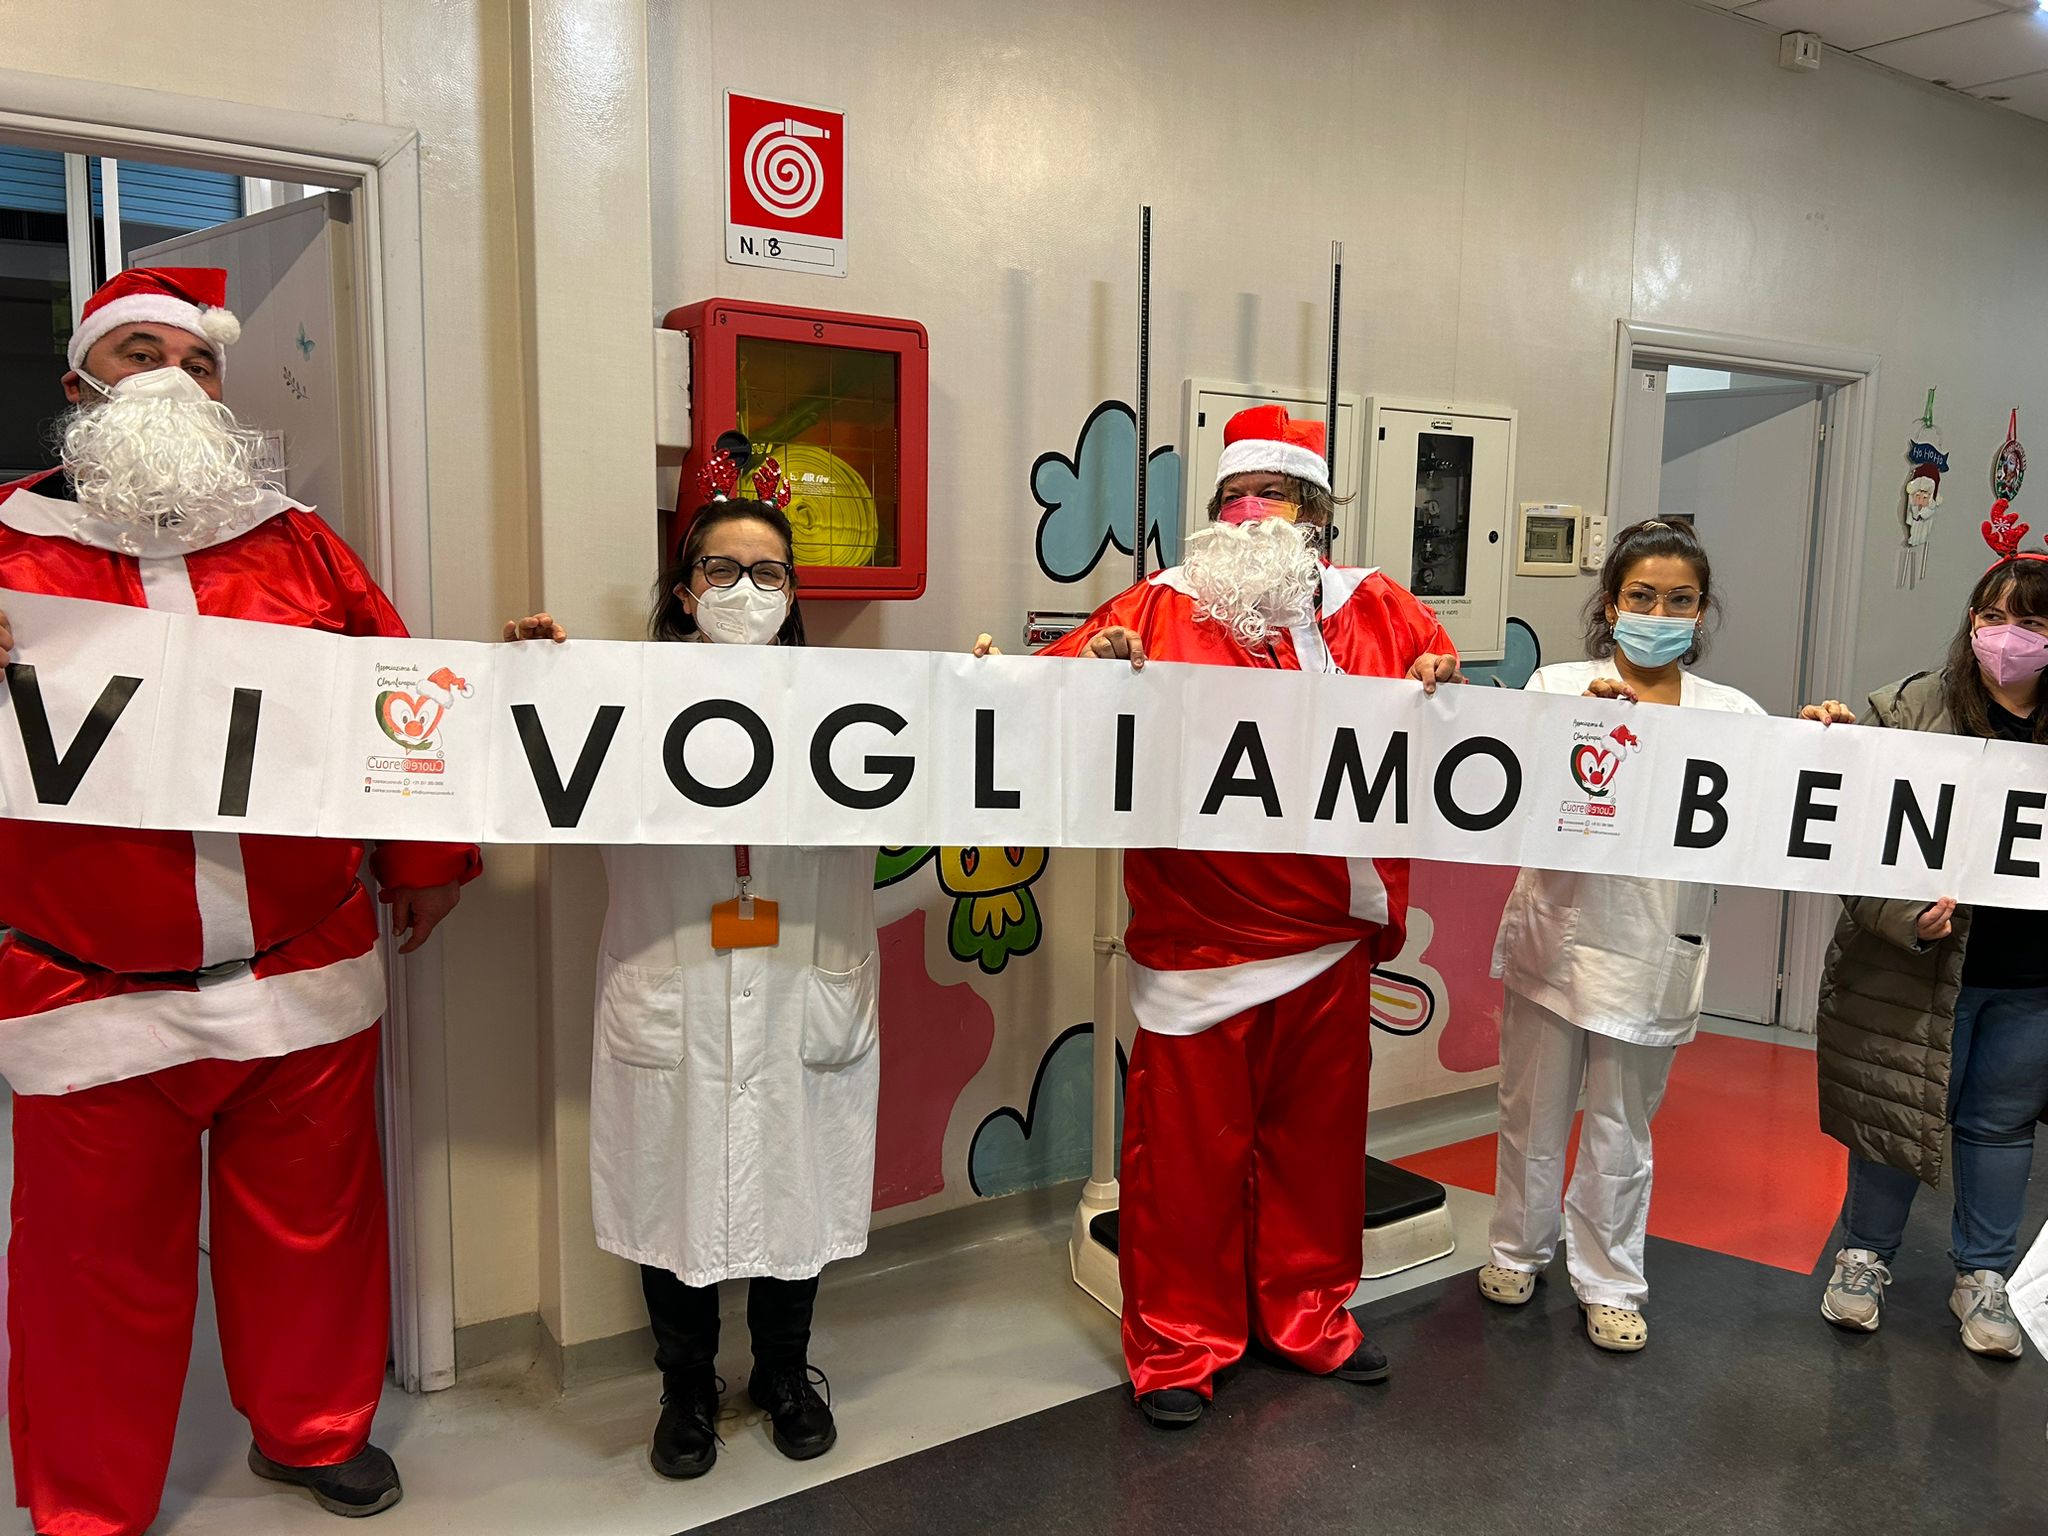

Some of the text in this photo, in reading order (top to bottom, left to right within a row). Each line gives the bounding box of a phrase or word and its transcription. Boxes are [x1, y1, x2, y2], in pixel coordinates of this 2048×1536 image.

[740, 236, 781, 257] N. 8
[813, 323, 824, 339] 8
[8, 663, 2047, 878] VI VOGLIAMO BENE
